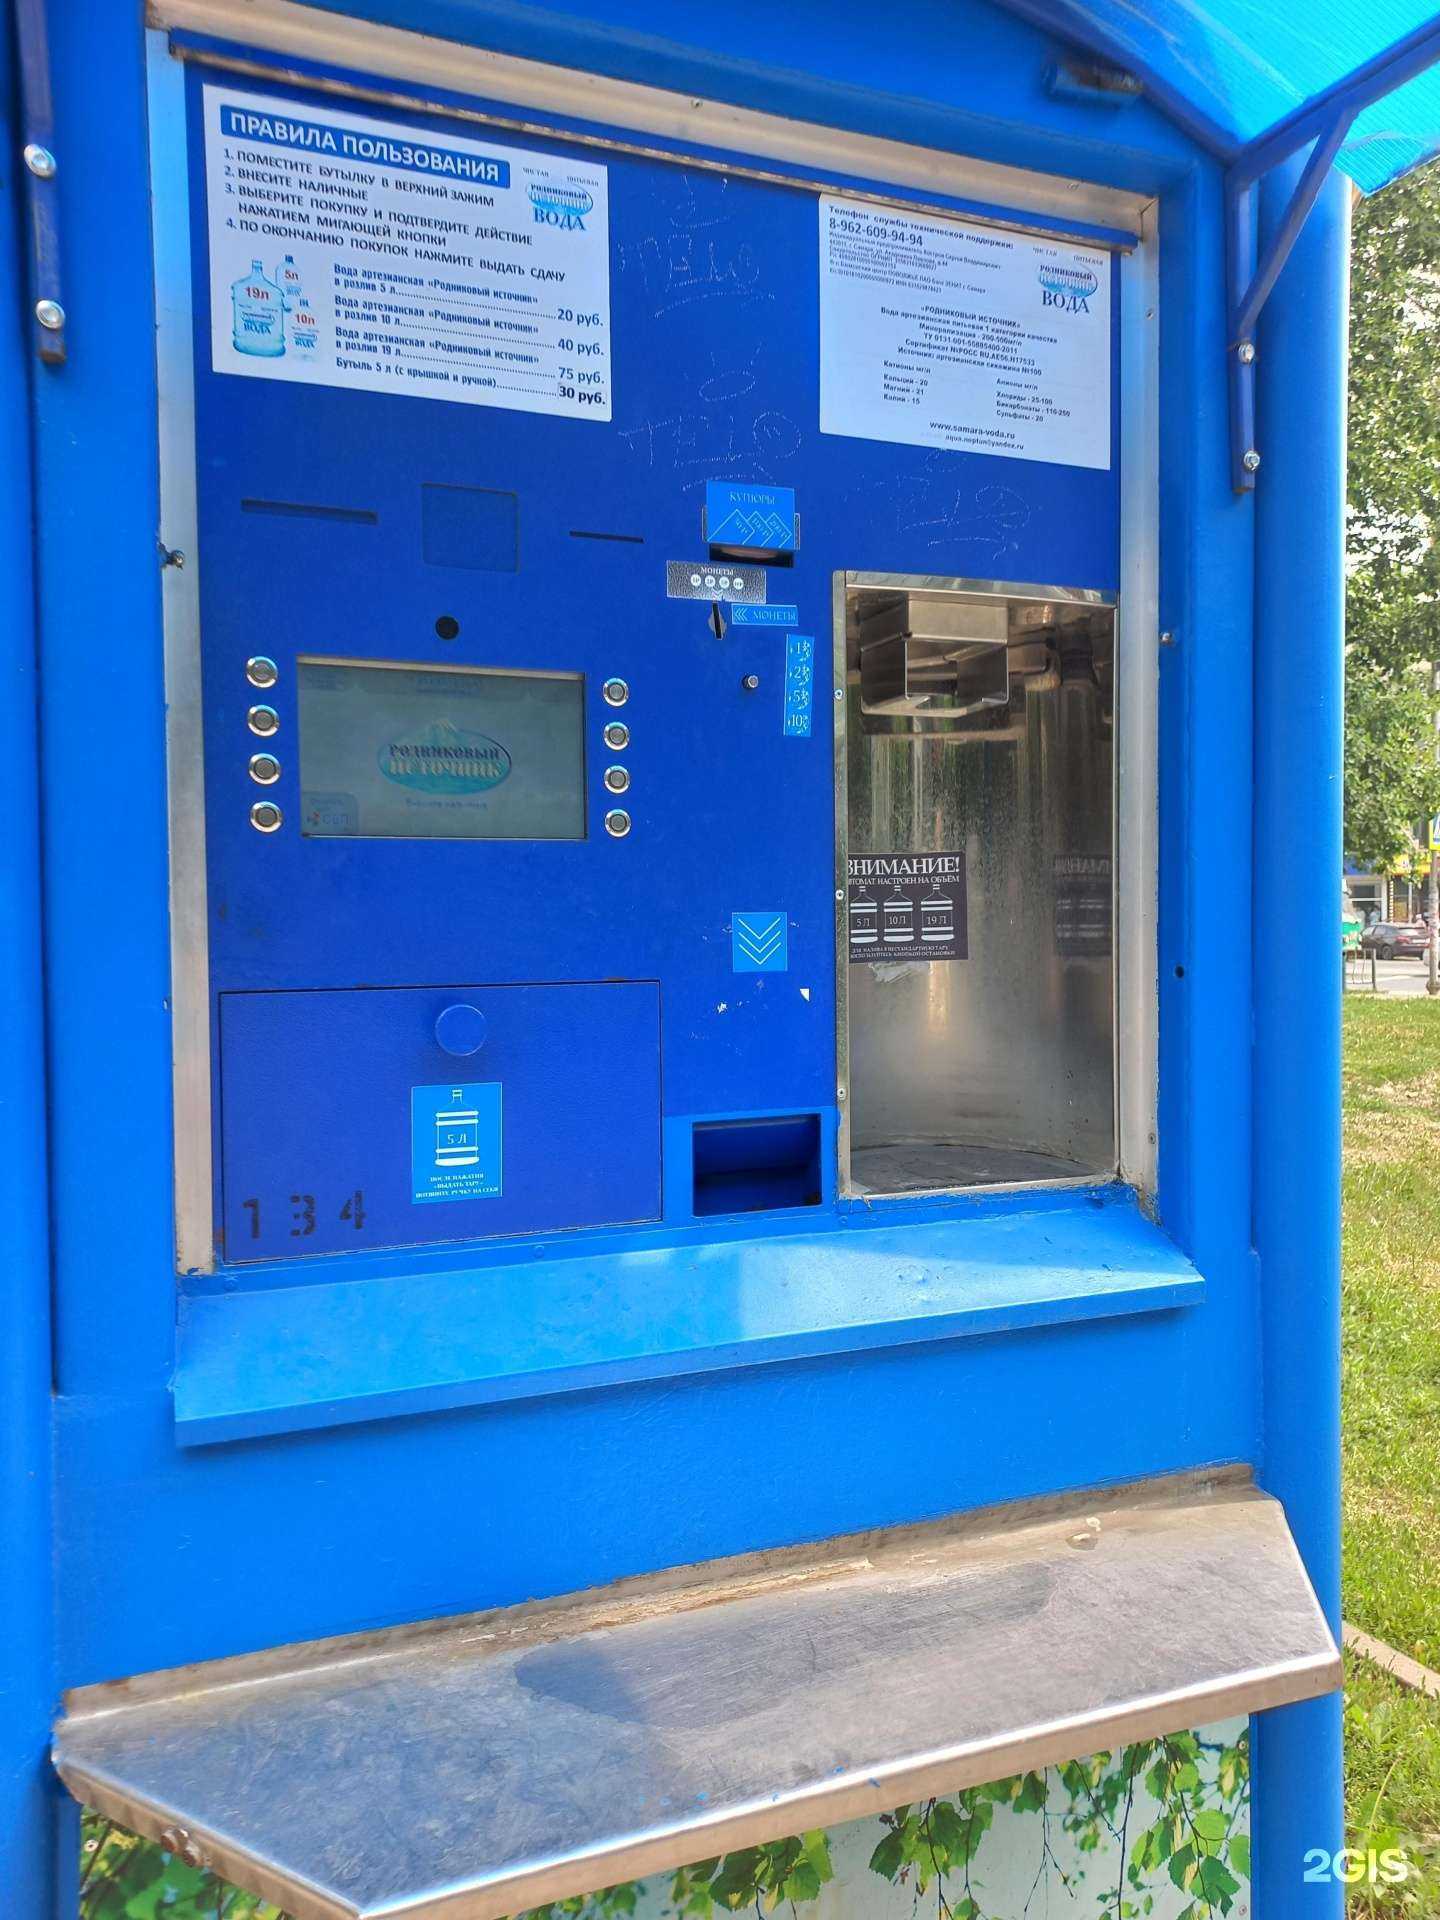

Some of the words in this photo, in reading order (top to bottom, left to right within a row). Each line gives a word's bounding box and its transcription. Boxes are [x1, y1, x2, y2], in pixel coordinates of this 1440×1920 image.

[229, 111, 336, 152] ПРАВИЛА
[342, 134, 499, 183] ПОЛЬЗОВАНИЯ
[224, 148, 234, 160] 1.
[236, 150, 312, 174] ПОМЕСТИТЕ
[318, 165, 375, 186] БУТЫЛКУ
[381, 177, 388, 188] В
[395, 177, 447, 199] ВЕРХНИЙ
[450, 189, 494, 207] ЗАЖИМ
[224, 165, 234, 177] 2.
[237, 167, 291, 187] ВНЕСИТЕ
[298, 178, 368, 201] НАЛИЧНЫЕ
[224, 182, 235, 195] 3.
[238, 185, 304, 206] ВЫБЕРИТЕ
[310, 197, 368, 217] ПОКУПКУ
[373, 208, 382, 220] И
[388, 211, 469, 237] ПОДТВЕРДИТЕ
[474, 223, 533, 247] ДЕЙСТВИЕ
[533, 206, 586, 233] ВОДА
[237, 202, 310, 224] НАЖАТИЕМ
[316, 213, 391, 239] МИГАЮЩЕЙ
[397, 229, 446, 247] КНОПКИ
[829, 205, 869, 222] Телефон
[873, 214, 907, 229] службы
[910, 222, 963, 239] технической
[966, 234, 1013, 250] поддержки:
[829, 216, 923, 246] 8-962-609-94-94
[225, 217, 236, 229] 4.
[239, 219, 258, 232] ПО
[261, 223, 344, 246] ОКОНЧАНИЮ
[350, 237, 408, 257] ПОКУПОК
[414, 248, 474, 267] НАЖМИТЕ
[479, 259, 525, 278] ВЫДАТЬ
[530, 267, 565, 284] СДАЧУ
[333, 263, 358, 278] Вода
[361, 269, 424, 288] артезианская
[427, 278, 490, 298] «Родниковый
[492, 289, 538, 305] источник»
[334, 277, 340, 286] в
[343, 279, 376, 293] розлив
[379, 283, 386, 293] 5
[245, 286, 269, 301] 19л
[1041, 289, 1089, 315] ВОДА
[334, 294, 359, 309] Вода
[361, 299, 425, 318] артезианская
[428, 308, 490, 328] «Родниковый
[493, 320, 538, 335] источник»
[334, 308, 341, 317] в
[344, 310, 377, 324] розлив
[381, 314, 391, 324] 10
[557, 308, 573, 322] 20
[576, 310, 604, 329] руб.
[880, 306, 898, 317] Вода
[900, 311, 950, 326] артезианская
[951, 319, 983, 331] питьевая
[920, 304, 976, 321] «РОДНИКОВЫЙ
[978, 314, 1020, 328] ИСТОЧНИК»
[919, 322, 976, 339] Минерализация
[335, 326, 360, 340] Вода
[362, 331, 425, 349] артезианская
[429, 339, 491, 358] «Родниковый
[493, 350, 539, 364] источник»
[335, 340, 342, 348] в
[345, 341, 378, 354] розлив
[381, 345, 391, 355] 19
[557, 337, 573, 351] 40
[576, 339, 604, 358] руб.
[905, 338, 948, 352] Сертификат
[883, 359, 914, 371] Катионы
[935, 353, 985, 366] артезианская
[336, 356, 372, 372] Бутыль
[375, 362, 381, 371] 5
[384, 364, 391, 373] л
[394, 363, 405, 376] (с
[406, 366, 449, 382] крышкой
[557, 366, 574, 380] 75
[577, 368, 604, 386] руб.
[883, 373, 913, 384] Кальций
[919, 378, 928, 386] 20
[883, 383, 910, 393] Магний
[996, 377, 1023, 388] Анионы
[558, 385, 575, 399] 30
[578, 388, 606, 406] руб.
[883, 393, 905, 402] Калий
[911, 397, 920, 405] 15
[996, 390, 1026, 401] Хлориды
[996, 400, 1040, 413] Бикарбонаты
[996, 409, 1030, 421] Сульфаты
[1035, 414, 1044, 422] 20
[929, 420, 1015, 439] www.samara-voda.ru
[700, 566, 735, 576] МОНЕТЫ
[753, 609, 796, 621] МОНЕТЫ
[877, 876, 917, 886] НАСТРОЕН
[917, 876, 931, 884] НА
[888, 916, 898, 926] 10
[927, 916, 937, 926] 19
[447, 1133, 453, 1144] 5
[457, 1132, 466, 1144] Л
